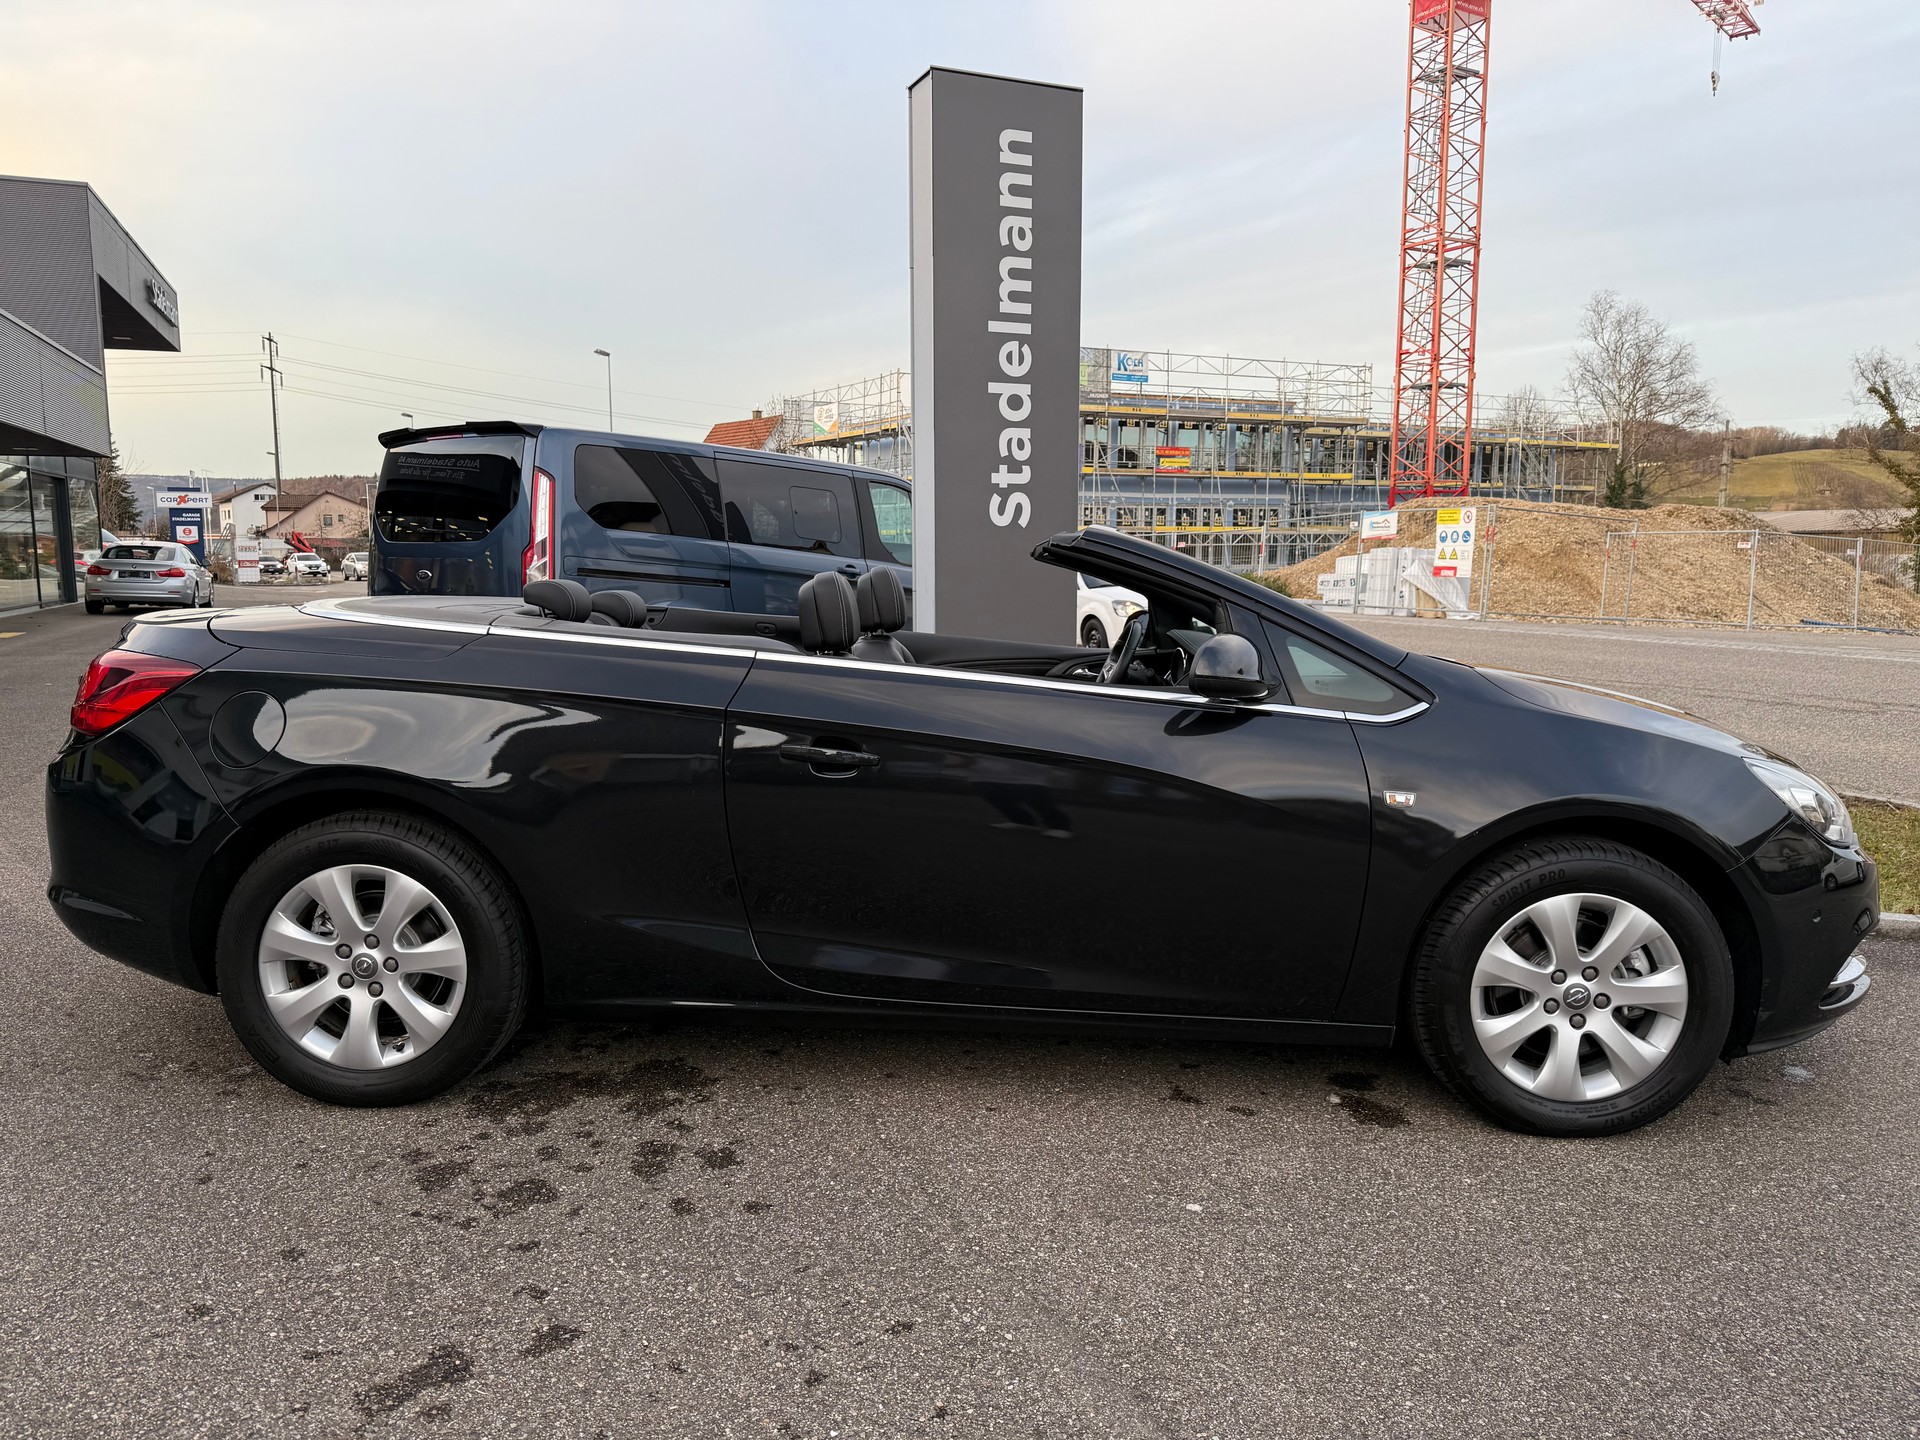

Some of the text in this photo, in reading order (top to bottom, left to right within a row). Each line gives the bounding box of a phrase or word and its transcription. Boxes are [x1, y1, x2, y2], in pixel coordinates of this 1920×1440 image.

[987, 128, 1034, 529] Stadelmann
[1491, 867, 1566, 910] SPIRIT PRO
[1601, 1113, 1626, 1130] R17
